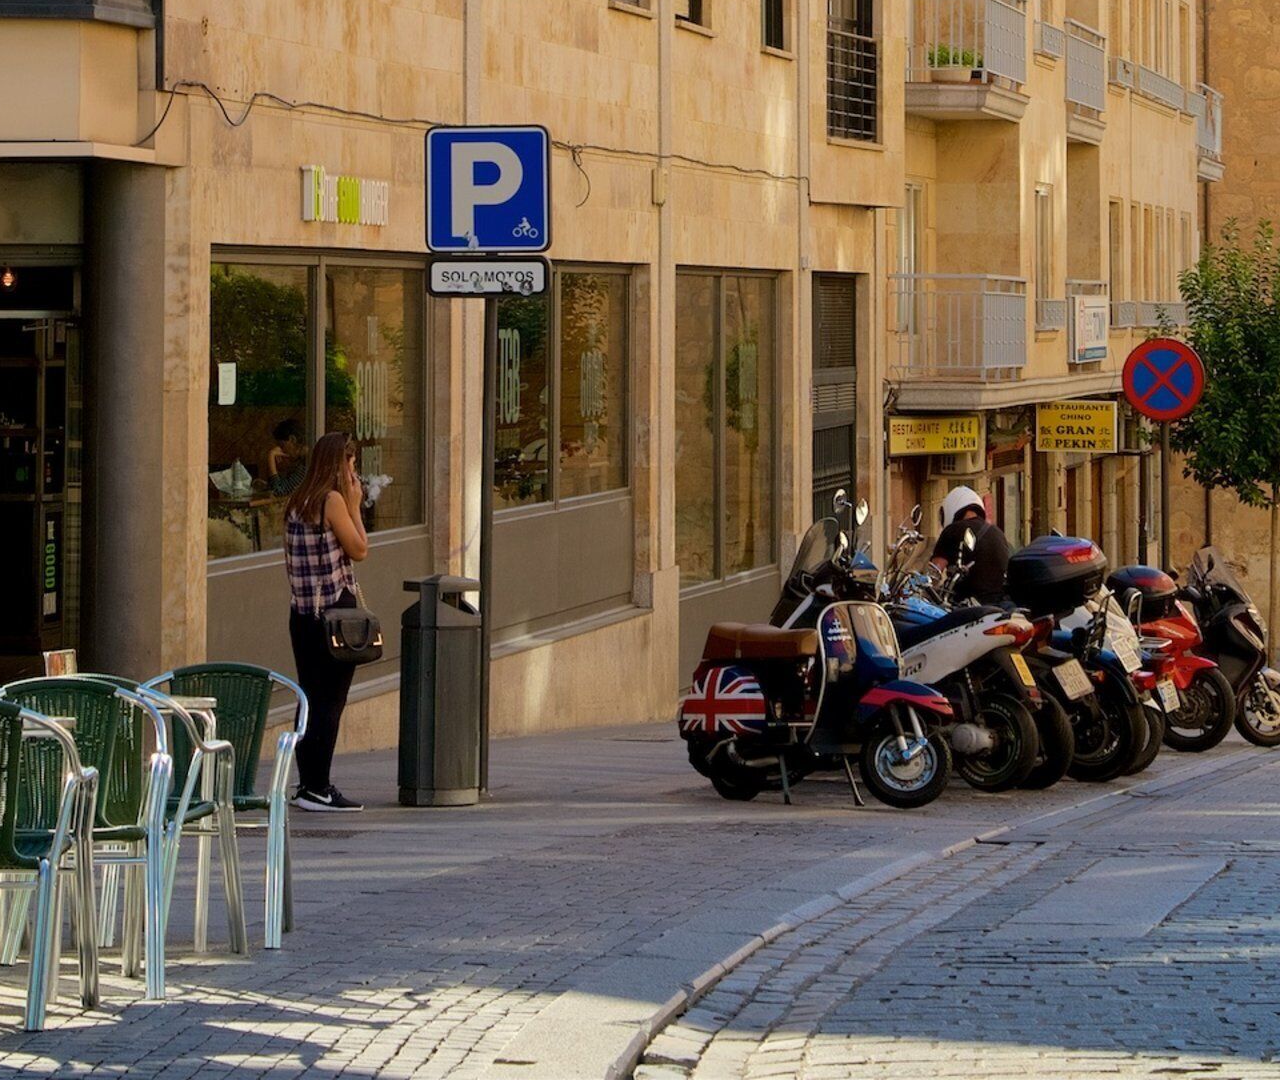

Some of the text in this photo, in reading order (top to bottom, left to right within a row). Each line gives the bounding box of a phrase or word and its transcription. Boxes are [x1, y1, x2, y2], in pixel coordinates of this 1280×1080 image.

[450, 141, 523, 238] P
[441, 270, 535, 283] SOLO MOTOS
[1040, 403, 1111, 411] RESTAURANTE
[1059, 413, 1092, 421] CHINO
[892, 422, 940, 435] RESTAURANTE
[1055, 426, 1096, 435] GRAN
[906, 437, 926, 449] CHINO
[1055, 438, 1096, 448] PEKIN
[45, 542, 56, 589] GOOD
